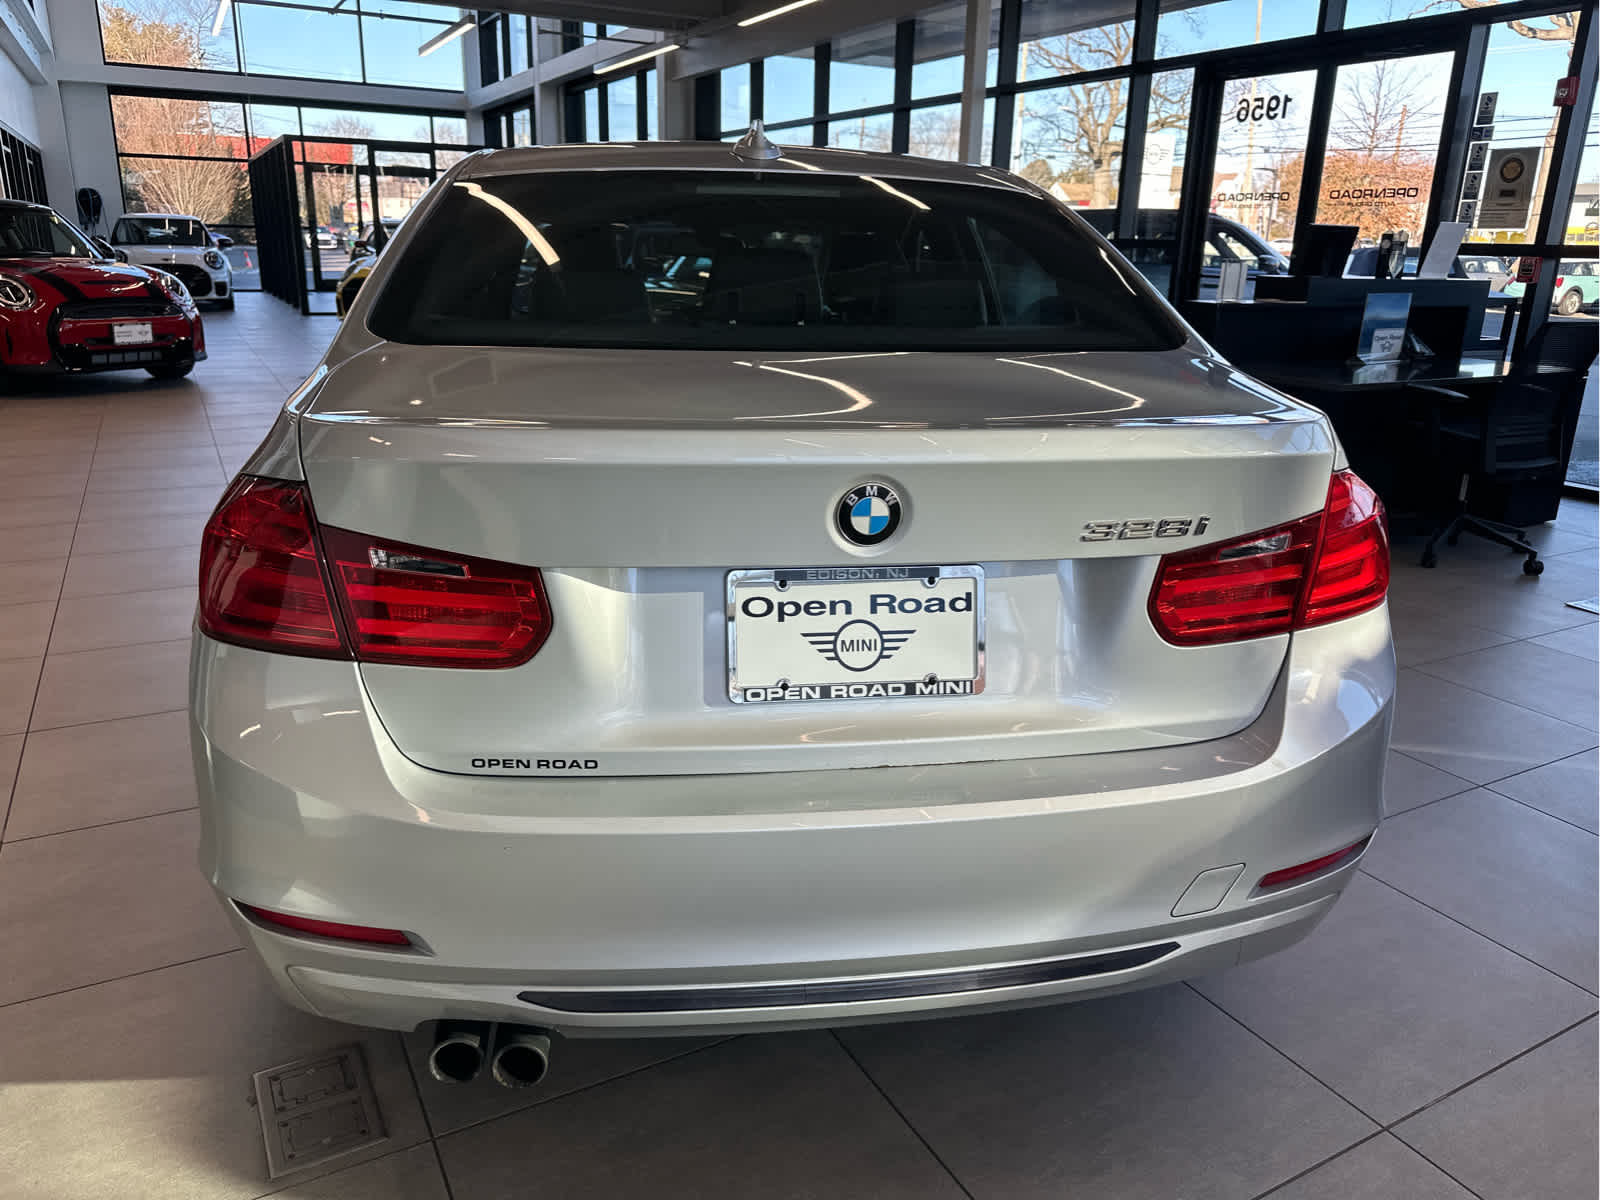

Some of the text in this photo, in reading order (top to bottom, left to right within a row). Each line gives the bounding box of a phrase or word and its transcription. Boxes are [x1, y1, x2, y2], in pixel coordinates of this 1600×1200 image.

[846, 485, 898, 506] BMW
[1080, 515, 1210, 541] 328i
[886, 568, 909, 579] NJ
[741, 592, 973, 622] Open Road
[840, 639, 878, 652] MINI
[745, 680, 974, 702] OPEN ROAD MINI
[471, 758, 598, 769] OPEN ROAD
